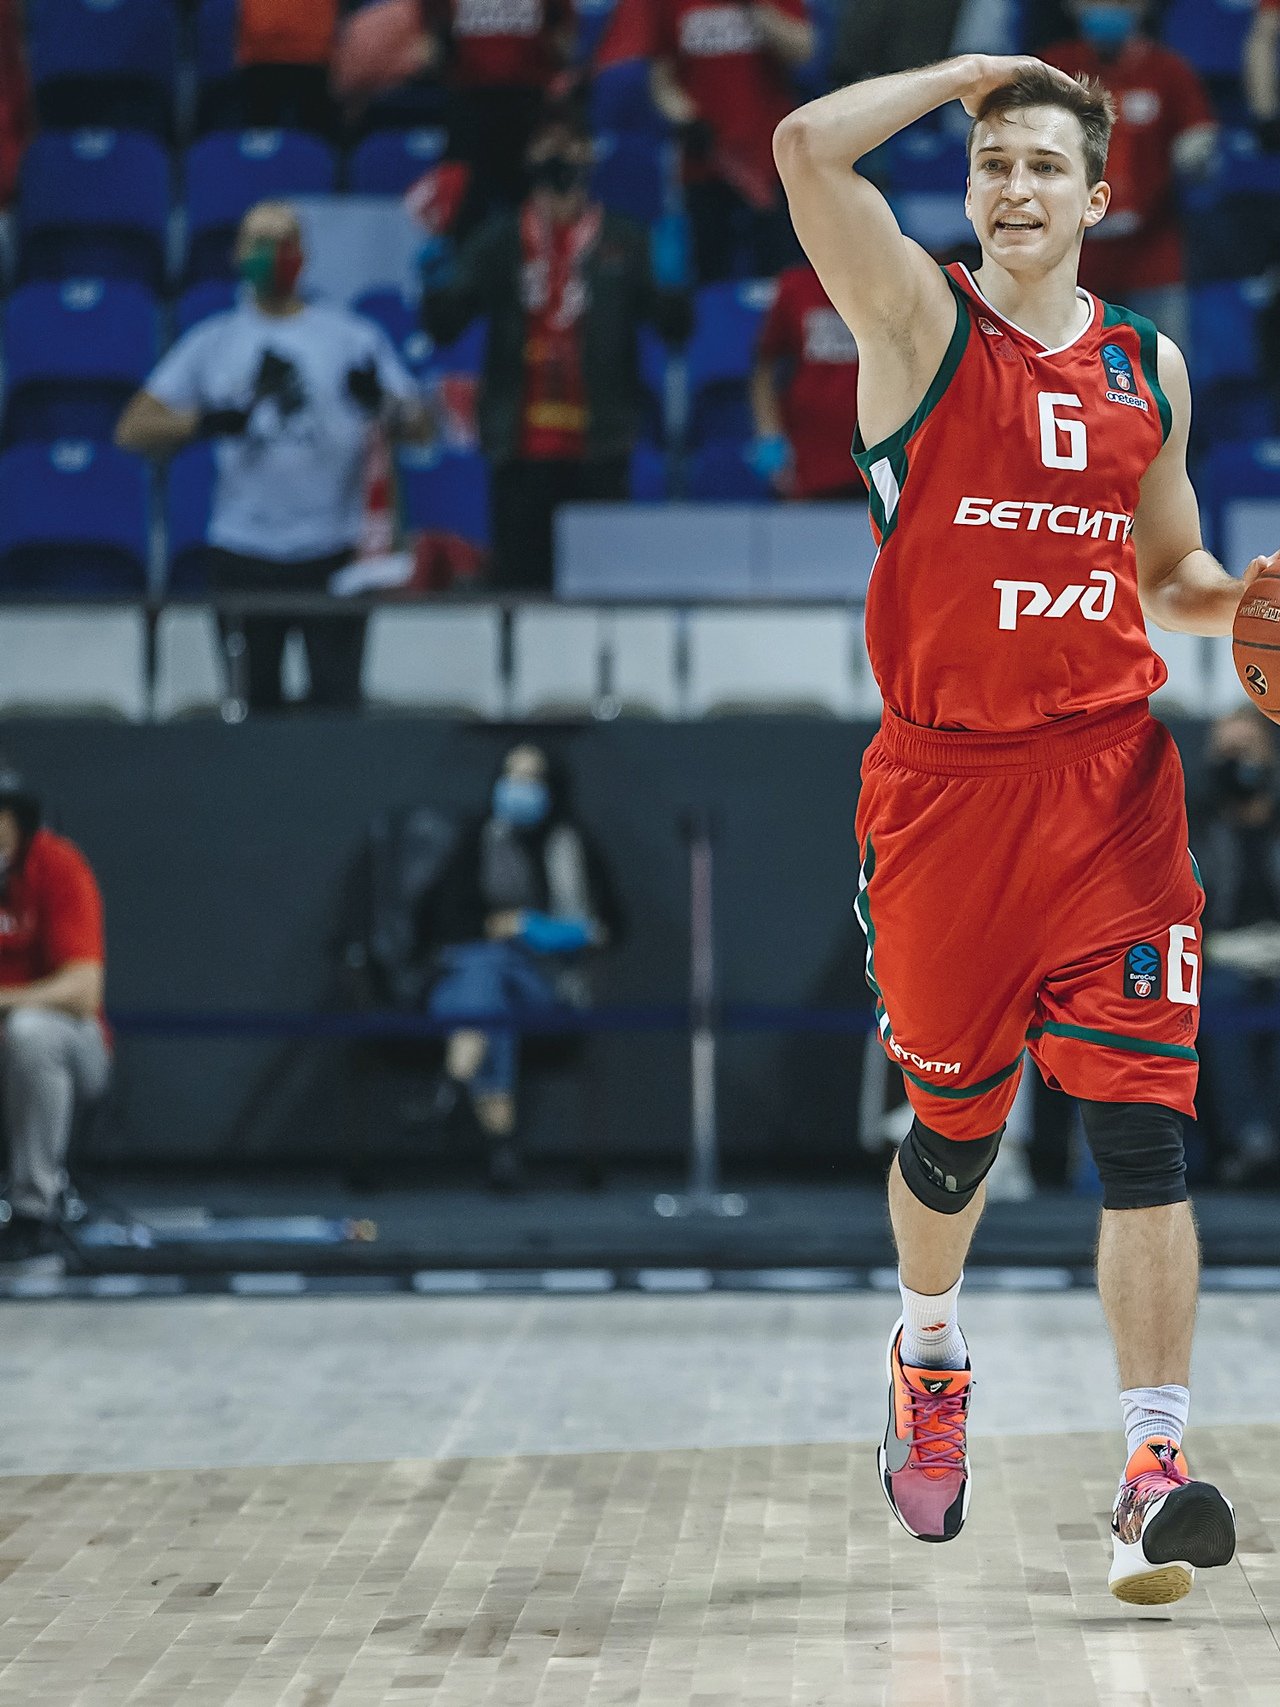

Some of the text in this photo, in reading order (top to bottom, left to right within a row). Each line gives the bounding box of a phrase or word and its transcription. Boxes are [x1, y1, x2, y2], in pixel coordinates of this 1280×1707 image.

[1037, 391, 1087, 471] 6
[1129, 973, 1156, 981] EuroCup
[1167, 924, 1198, 1006] 6
